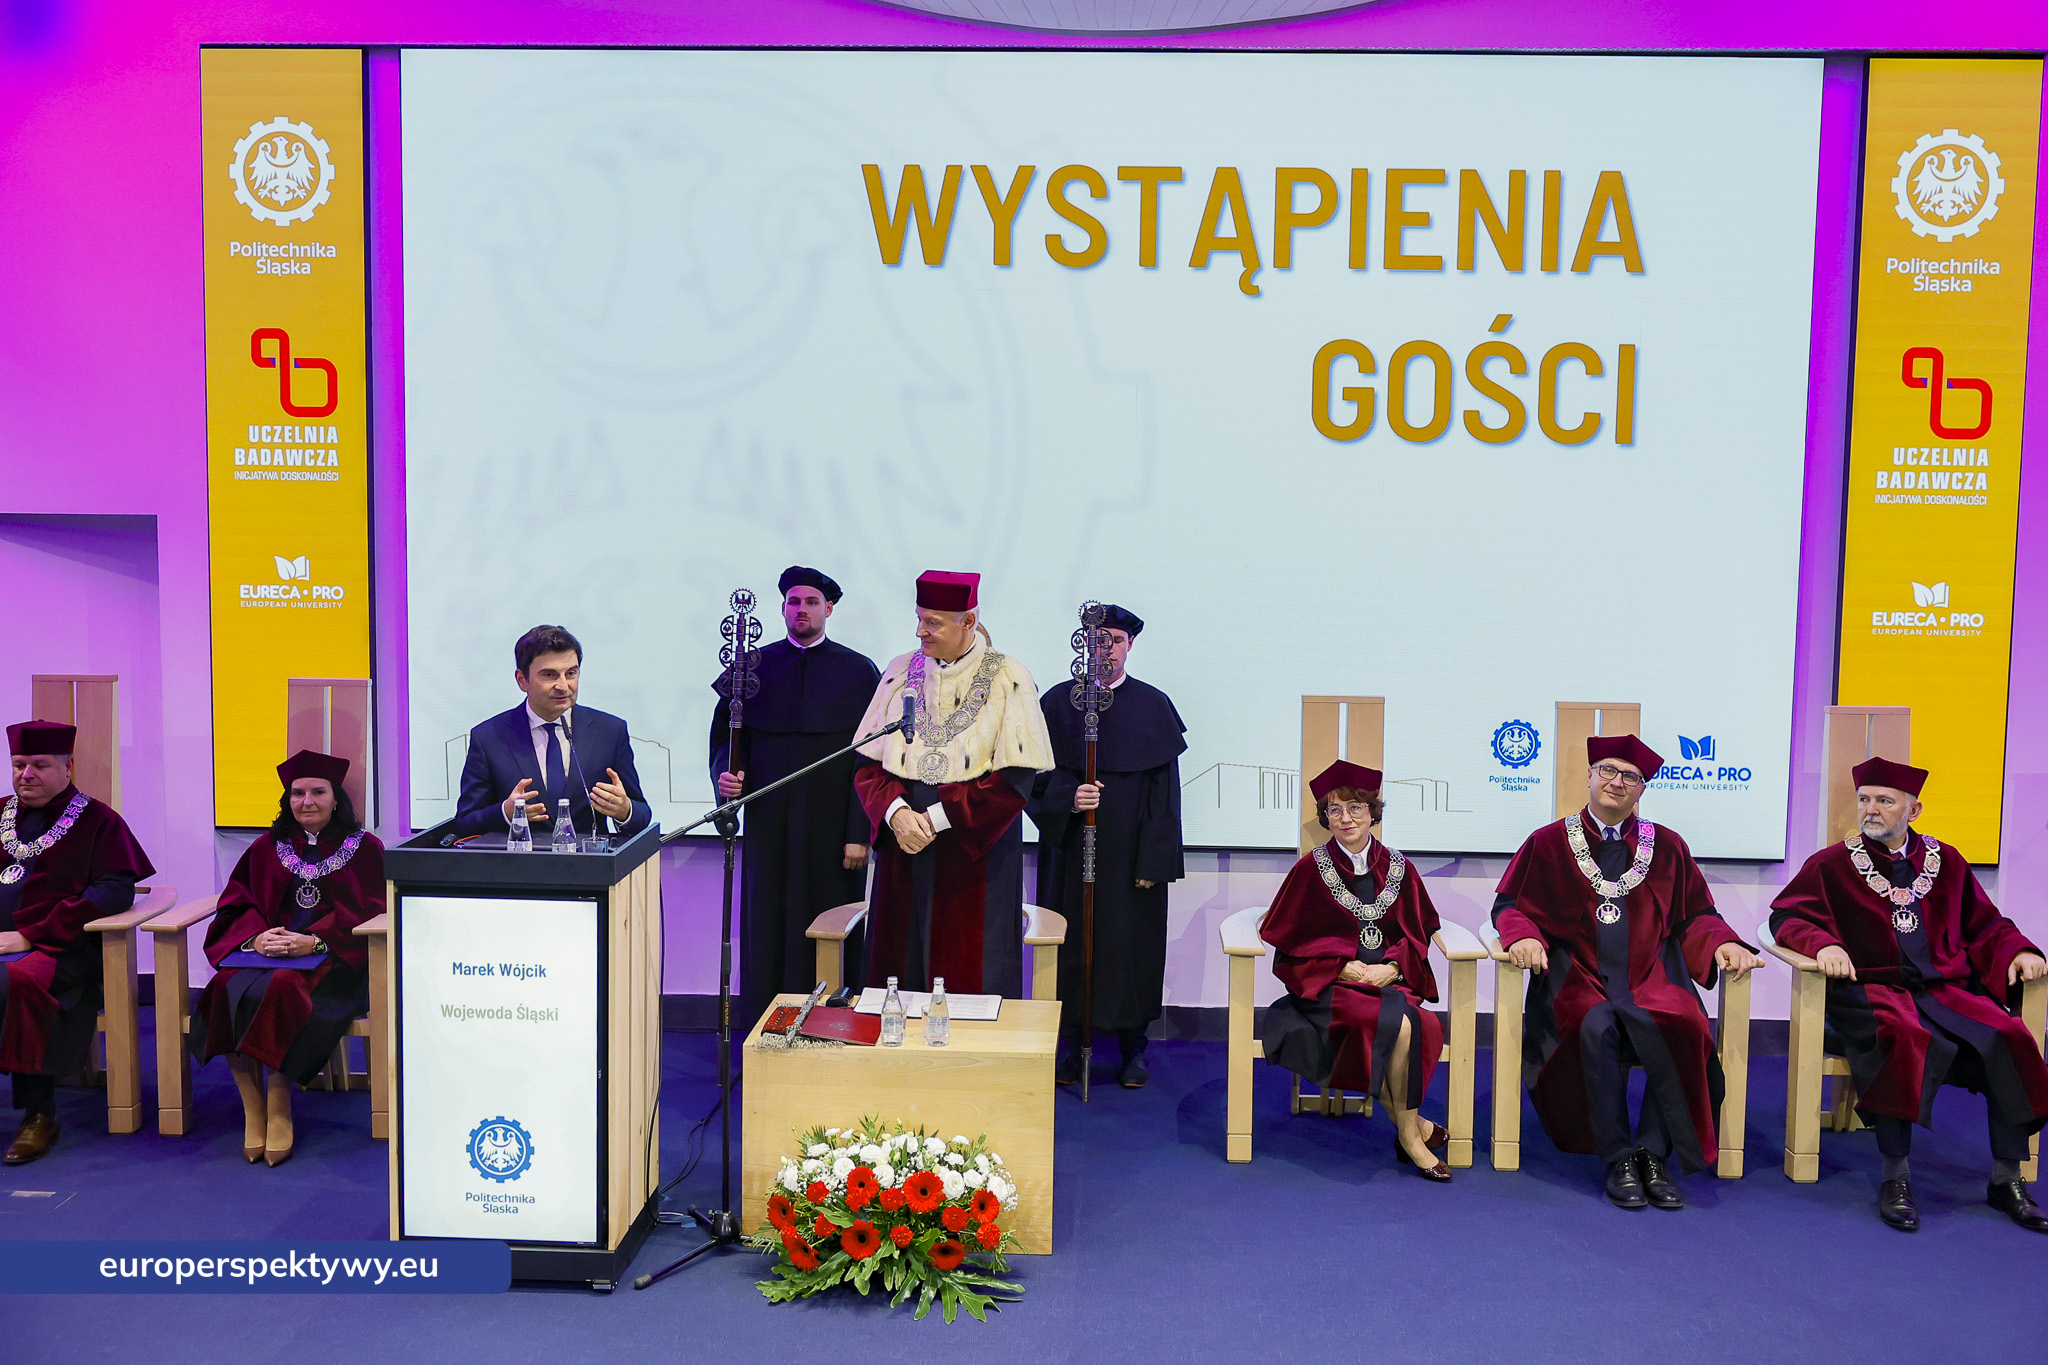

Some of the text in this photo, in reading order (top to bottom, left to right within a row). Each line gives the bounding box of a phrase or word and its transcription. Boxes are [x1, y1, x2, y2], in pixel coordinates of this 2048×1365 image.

[861, 163, 1645, 297] WYSTĄPIENIA
[229, 241, 337, 258] Politechnika
[256, 257, 312, 277] Śląska
[1886, 257, 2001, 275] Politechnika
[1913, 274, 1973, 295] Śląska
[1311, 314, 1637, 446] GOŚCI
[248, 424, 339, 444] UCZELNIA
[234, 447, 339, 467] BADAWCZA
[1893, 447, 1990, 467] UCZELNIA
[234, 470, 339, 482] INICJATYWA DOSKONAŁOŚCI
[1876, 471, 1988, 491] BADAWCZA
[1874, 494, 1988, 506] INICJATYWA DOSKONAŁOŚCI
[239, 584, 345, 600] EURECA PRO
[240, 600, 343, 609] EUROPEAN UNIVERSITY
[1871, 611, 1985, 628] EURECA PRO
[1871, 628, 1982, 637] EUROPEAN UNIVERSITY
[1489, 776, 1541, 785] Politechnika
[1717, 767, 1752, 782] PRO
[1501, 783, 1528, 792] Śląska
[1692, 783, 1750, 791] UNIVERSITY
[452, 962, 547, 981] Marek Wójcik
[440, 1003, 559, 1024] Wojewoda Śląski
[465, 1192, 536, 1204] Politechnika
[482, 1202, 519, 1215] Śląska
